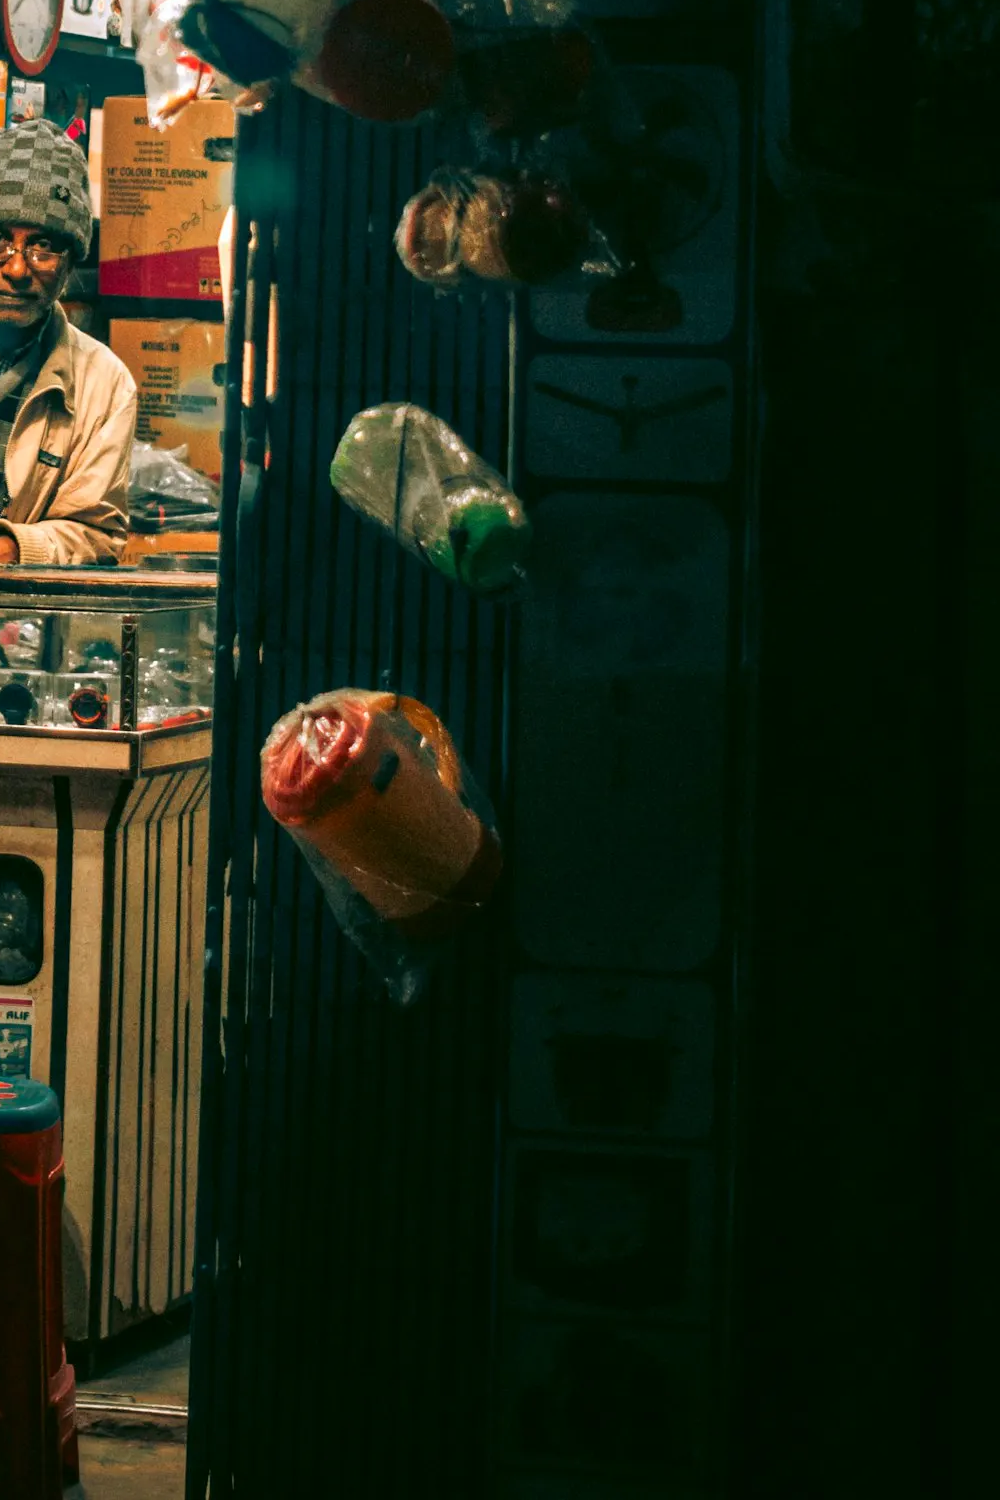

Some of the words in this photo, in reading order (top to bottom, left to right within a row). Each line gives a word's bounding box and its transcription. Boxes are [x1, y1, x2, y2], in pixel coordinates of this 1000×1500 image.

[119, 167, 153, 177] COLOUR
[155, 168, 208, 179] TELEVISION
[6, 1010, 30, 1021] ALIF
